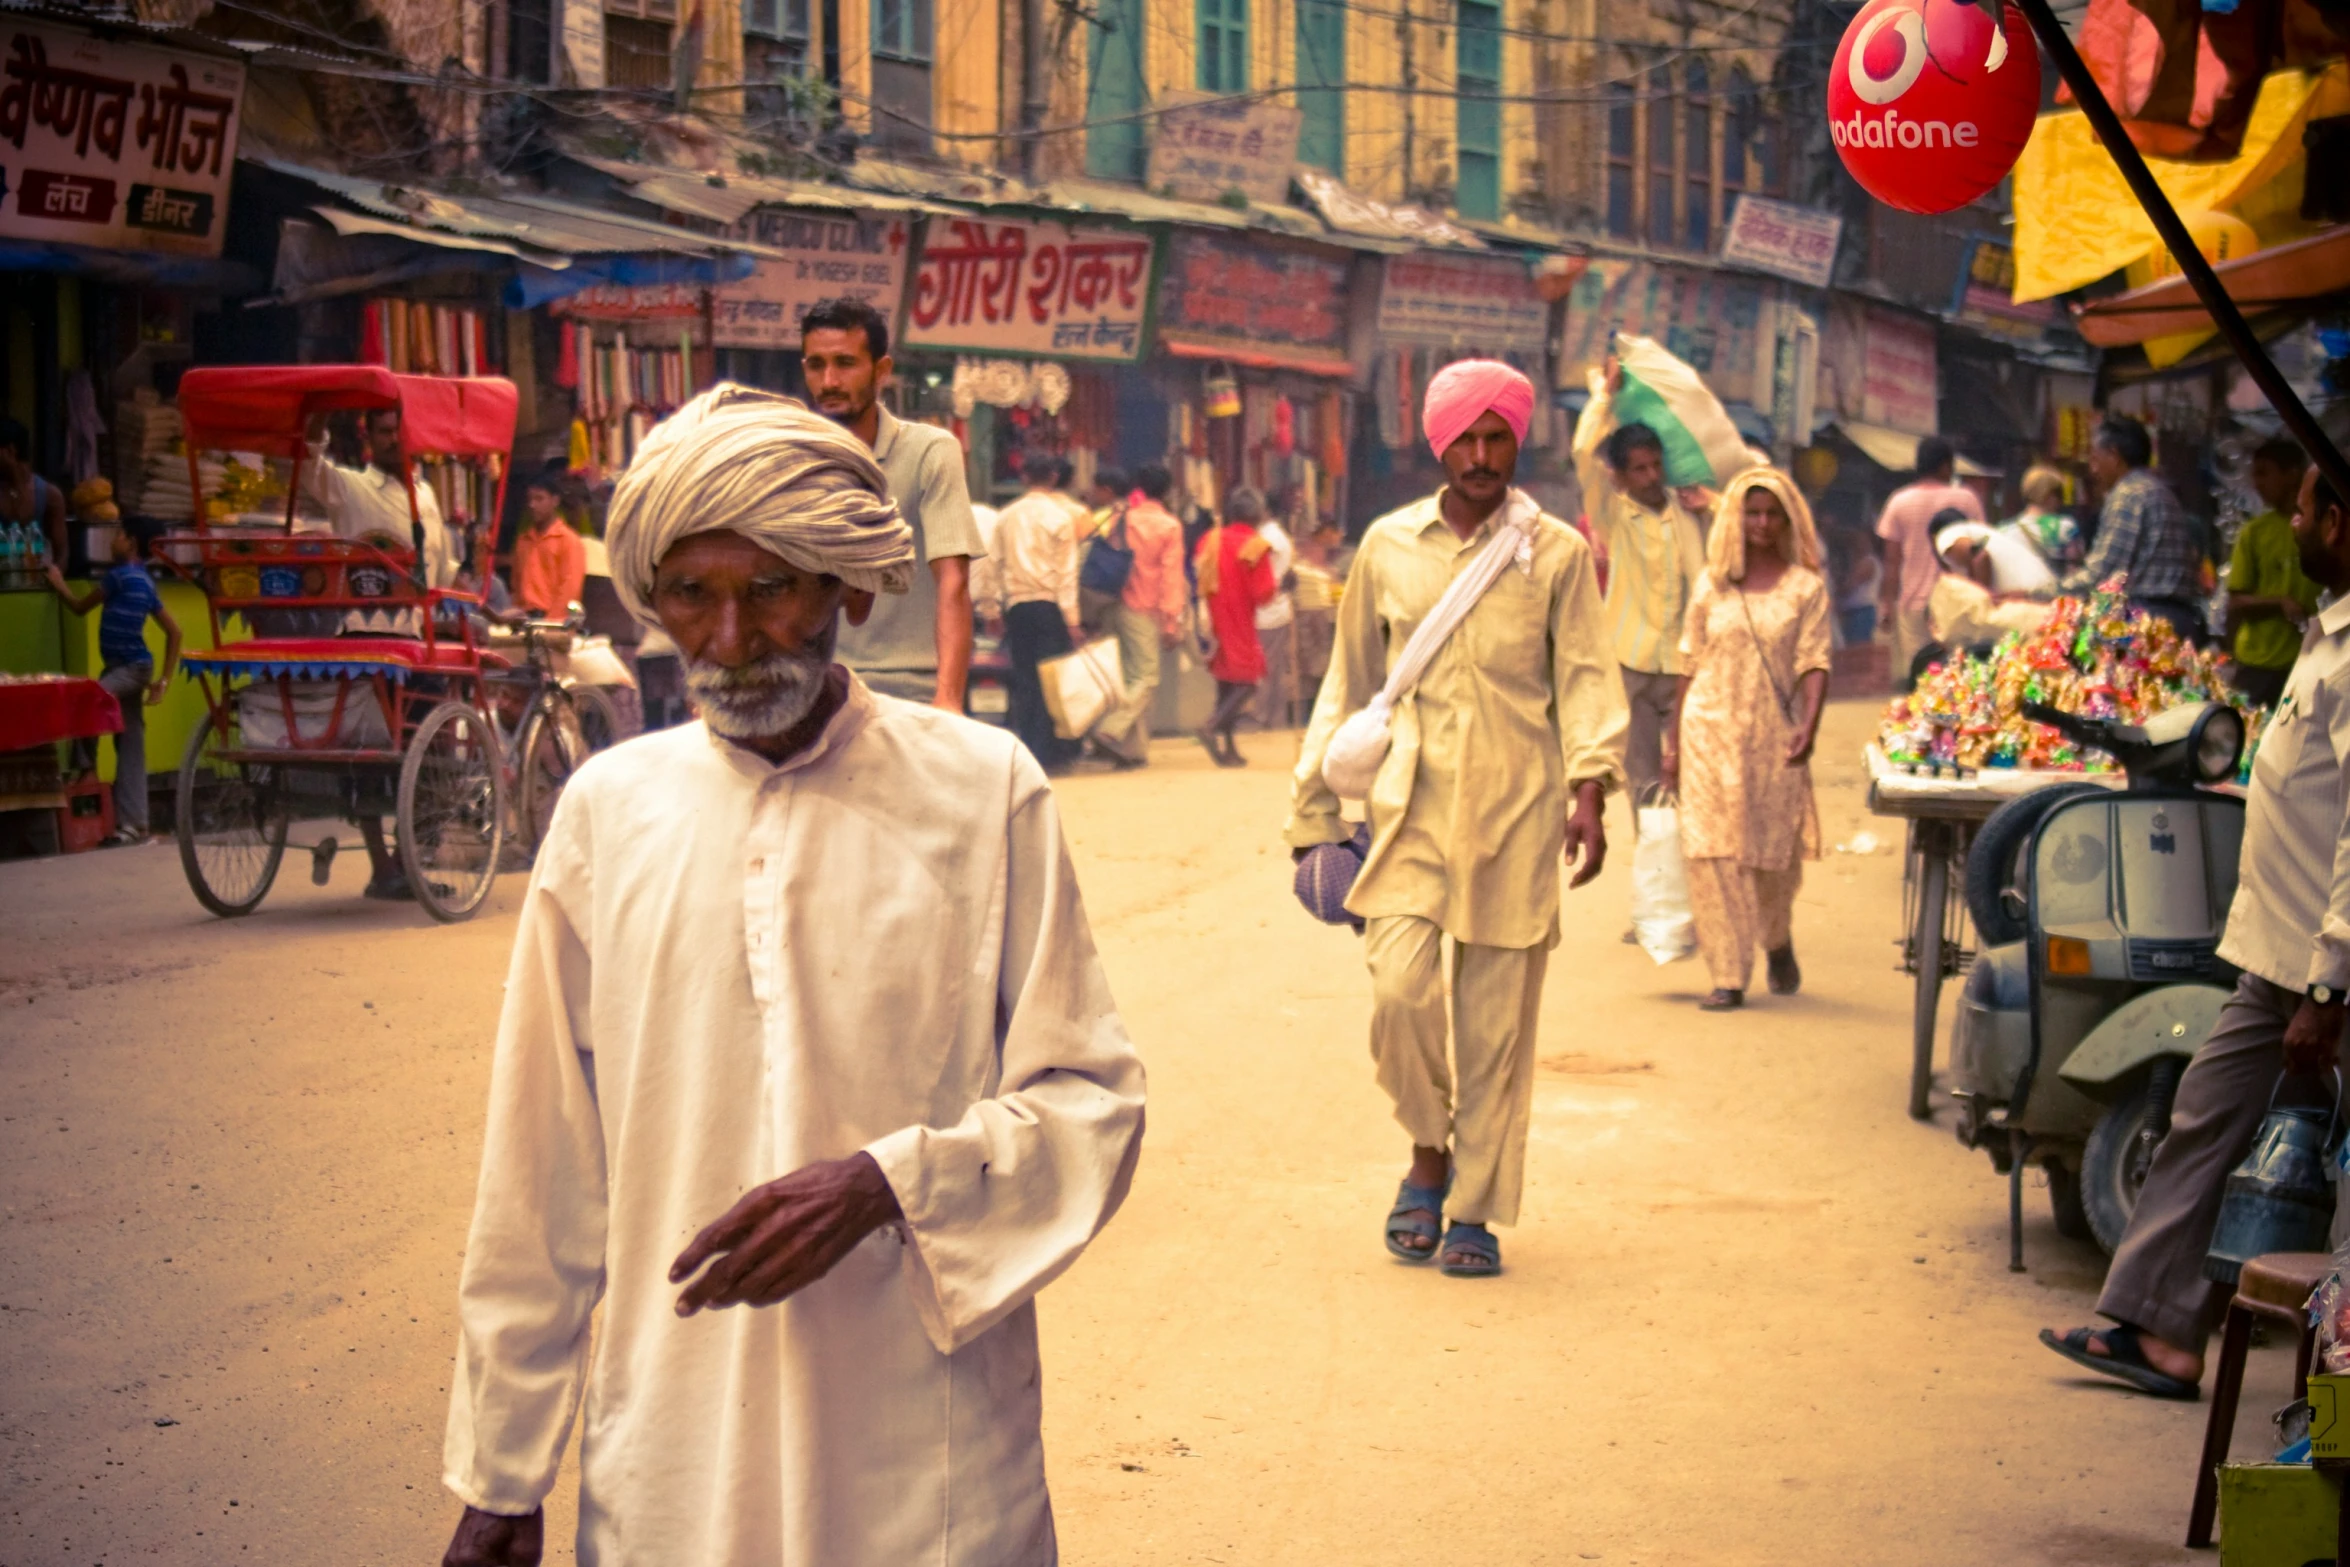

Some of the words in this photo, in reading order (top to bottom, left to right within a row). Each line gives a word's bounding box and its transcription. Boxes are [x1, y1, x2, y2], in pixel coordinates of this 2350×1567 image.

[136, 63, 234, 177] भोज
[44, 176, 92, 214] लंच
[911, 219, 1026, 329] गौरी
